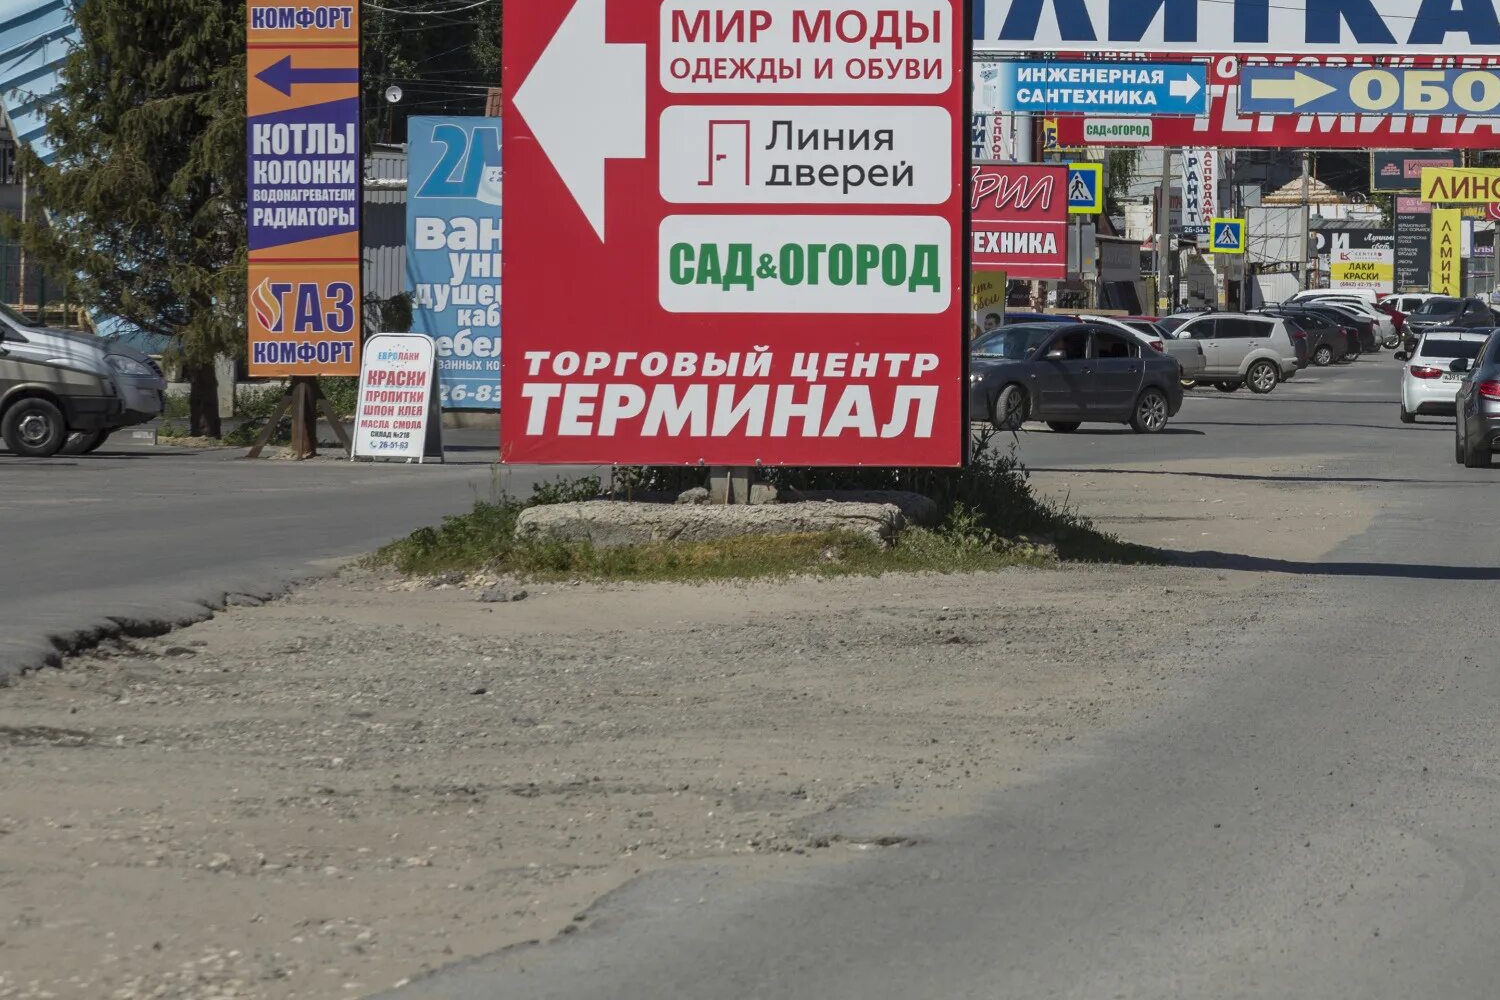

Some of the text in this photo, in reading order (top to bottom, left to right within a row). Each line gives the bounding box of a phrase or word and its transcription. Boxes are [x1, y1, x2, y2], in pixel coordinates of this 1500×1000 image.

[251, 6, 353, 31] КОМФОРТ
[671, 9, 942, 50] МИР МОДЫ
[669, 57, 944, 84] ОДЕЖДЫ И ОБУВИ
[1017, 67, 1165, 84] ИНЖЕНЕРНАЯ
[1016, 88, 1157, 105] САНТЕХНИКА
[252, 122, 356, 156] КОТЛЫ
[766, 119, 895, 151] Линия
[1086, 125, 1150, 137] САД&ОГОРОД
[253, 158, 356, 187] КОЛОНКИ
[765, 158, 915, 195] дверей
[253, 188, 356, 204] ВОДОНАГРЕВАТЕЛИ
[253, 205, 356, 230] РАДИАТОРЫ
[972, 231, 1058, 254] ЕХНИКА
[668, 242, 942, 294] САД&ОГОРОД
[1343, 272, 1379, 280] КРАСКИ
[273, 282, 355, 333] ГАЗ
[253, 340, 354, 365] КОМФОРТ
[378, 351, 420, 360] ЕВРОЛАКИ
[523, 344, 940, 382] ТОРГОВЫЙ ЦЕНТР
[367, 370, 427, 386] КРАСКИ
[365, 390, 425, 402] ПРОПИТКИ
[363, 405, 423, 416] ШПОН КЛЕЯ
[521, 382, 940, 438] ТЕРМИНАЛ
[361, 419, 422, 430] МАСЛА СМОЛА
